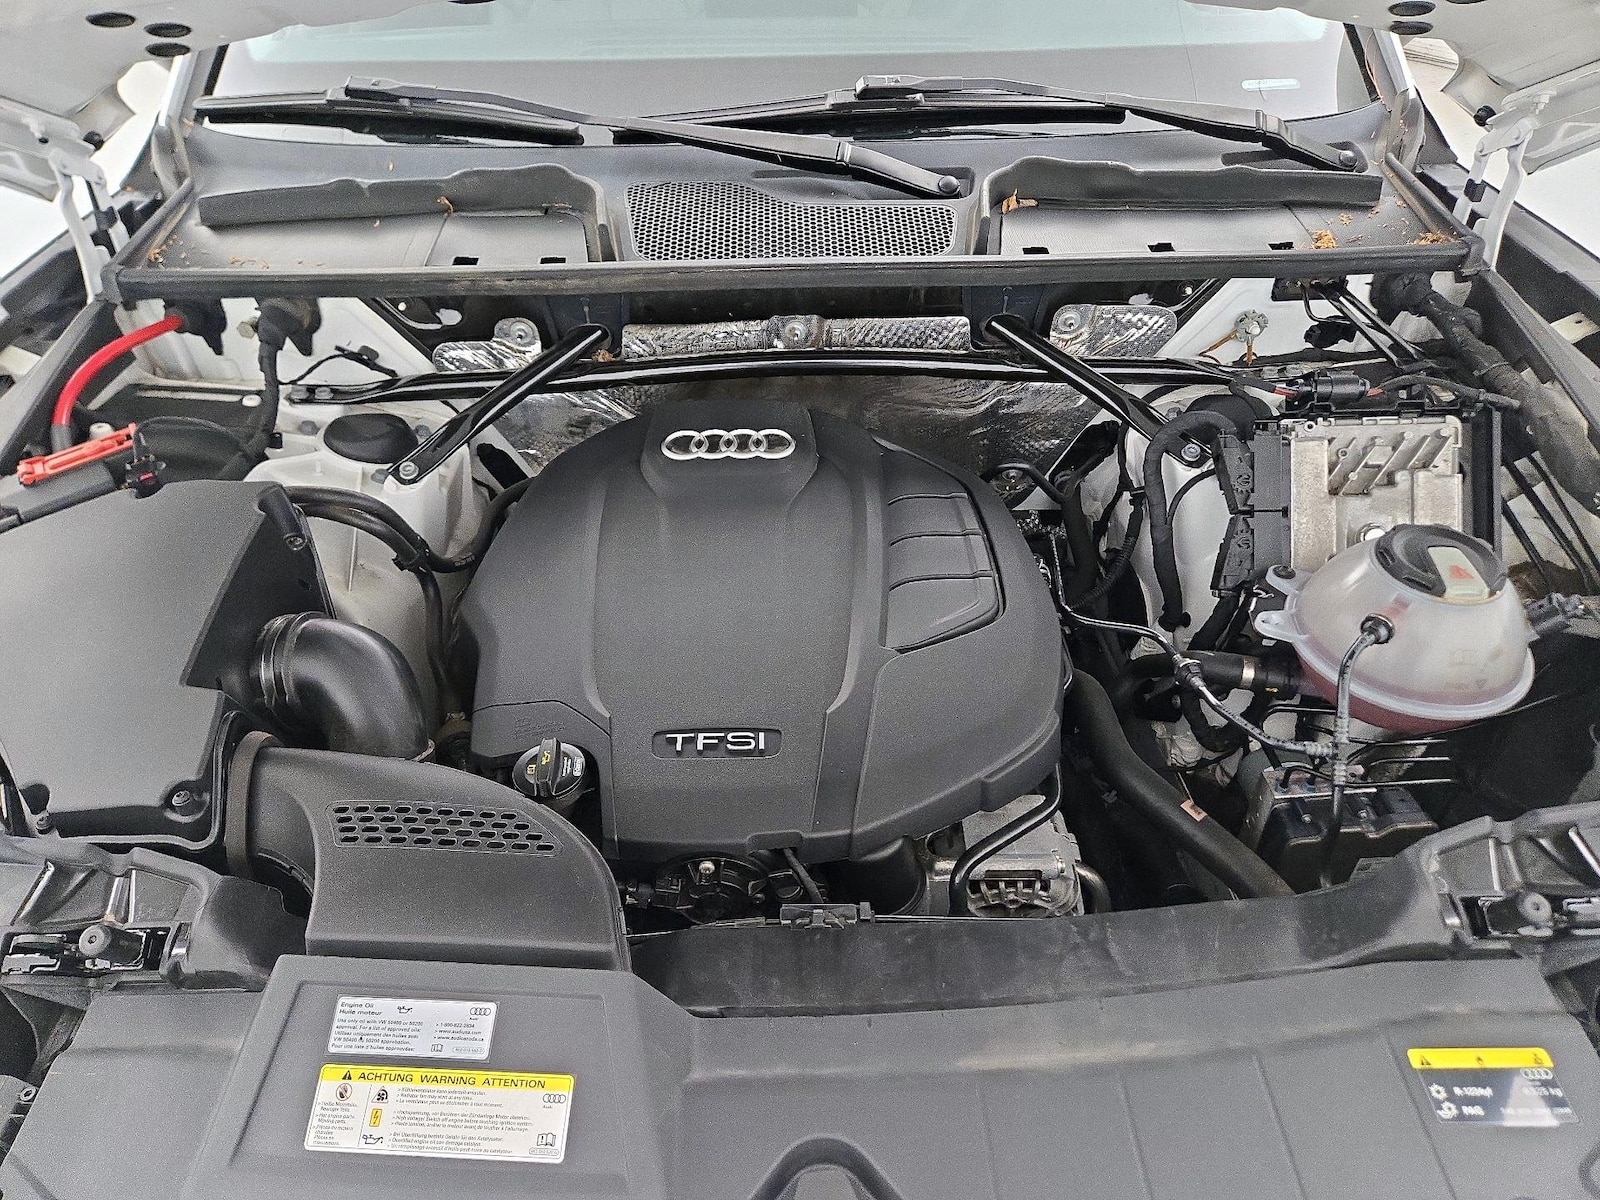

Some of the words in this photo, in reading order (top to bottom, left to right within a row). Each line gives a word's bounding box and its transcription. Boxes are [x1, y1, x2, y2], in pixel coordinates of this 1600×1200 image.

[666, 732, 765, 750] TFSI
[358, 1072, 413, 1082] ACHTUNG
[420, 1075, 476, 1085] WARNING
[482, 1078, 546, 1088] ATTENTION
